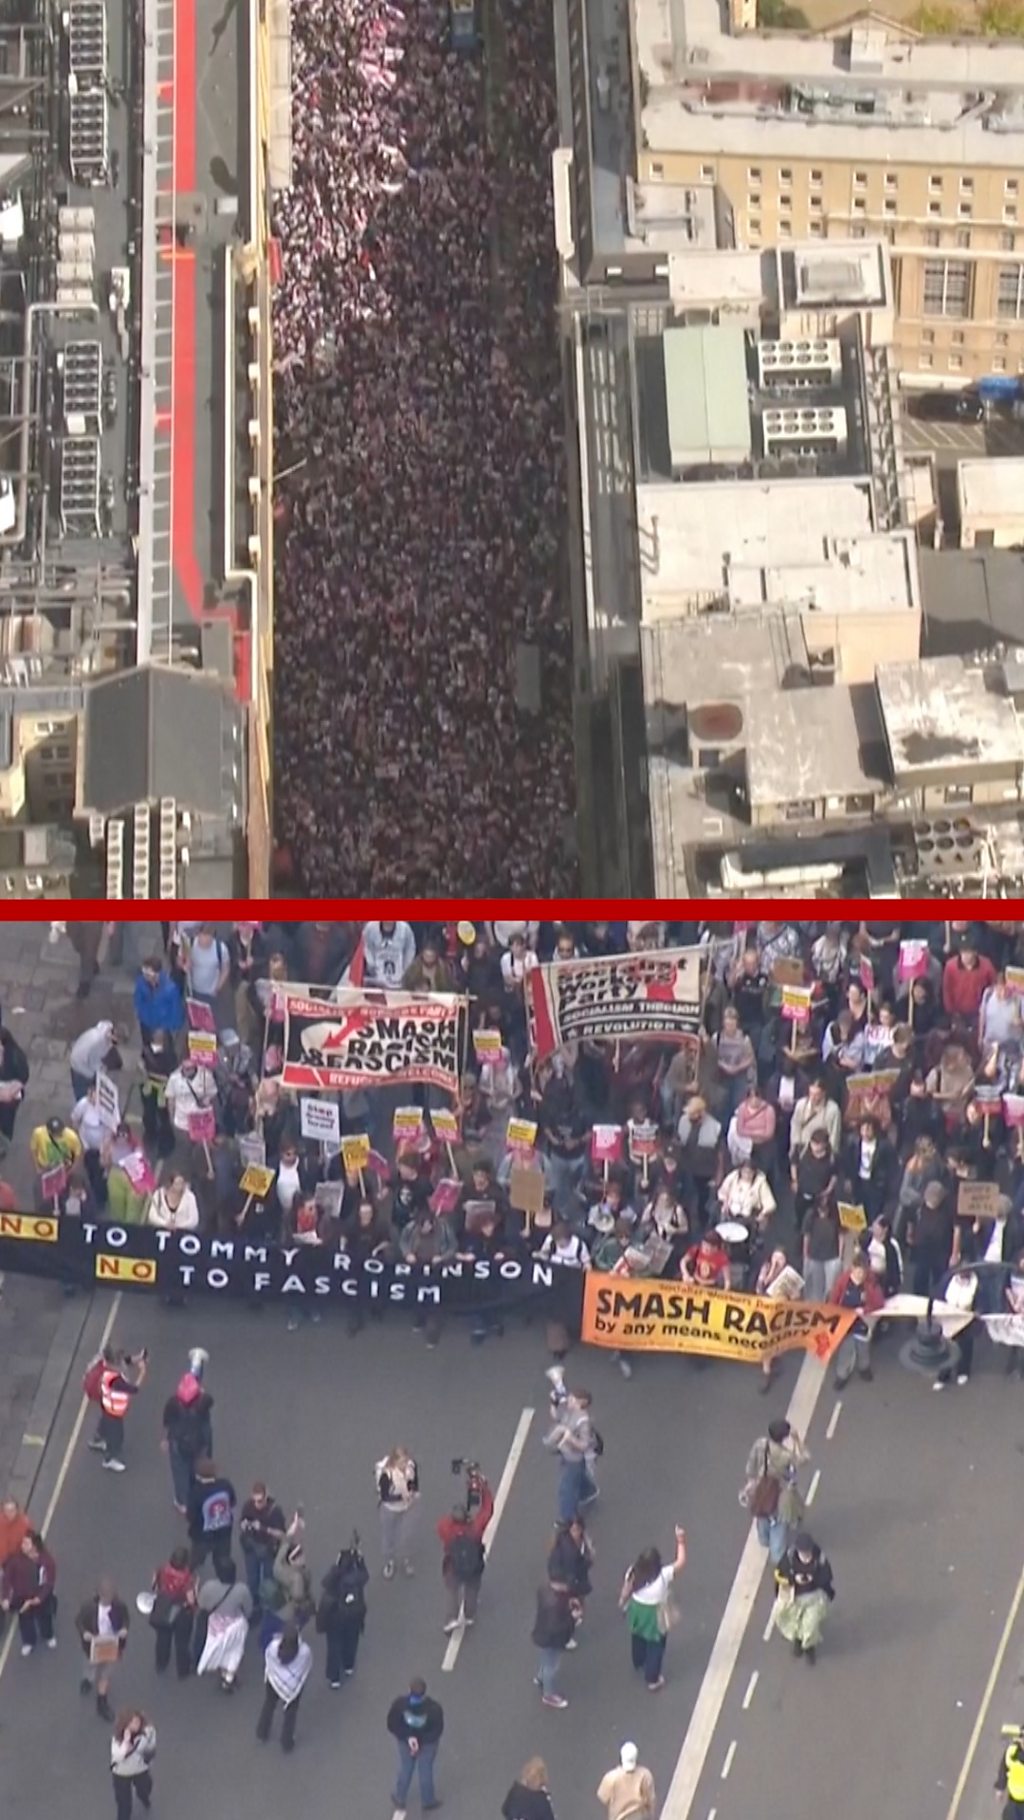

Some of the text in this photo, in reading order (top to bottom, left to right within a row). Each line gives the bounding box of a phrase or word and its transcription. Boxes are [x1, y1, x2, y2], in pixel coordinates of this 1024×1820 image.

[559, 983, 638, 1012] Party
[563, 1002, 635, 1023] SOCIALISM
[357, 1018, 455, 1040] SMASH
[583, 1020, 676, 1036] REVOLUTION
[348, 1033, 455, 1056] RACISM
[1, 1217, 54, 1236] NO
[83, 1224, 128, 1247] TO
[156, 1231, 299, 1266] TOMMY
[100, 1257, 440, 1303] NO TO FASCISM
[596, 1288, 840, 1336] SMASH RACISM
[595, 1314, 616, 1333] by
[623, 1323, 656, 1335] any
[662, 1323, 721, 1341] means
